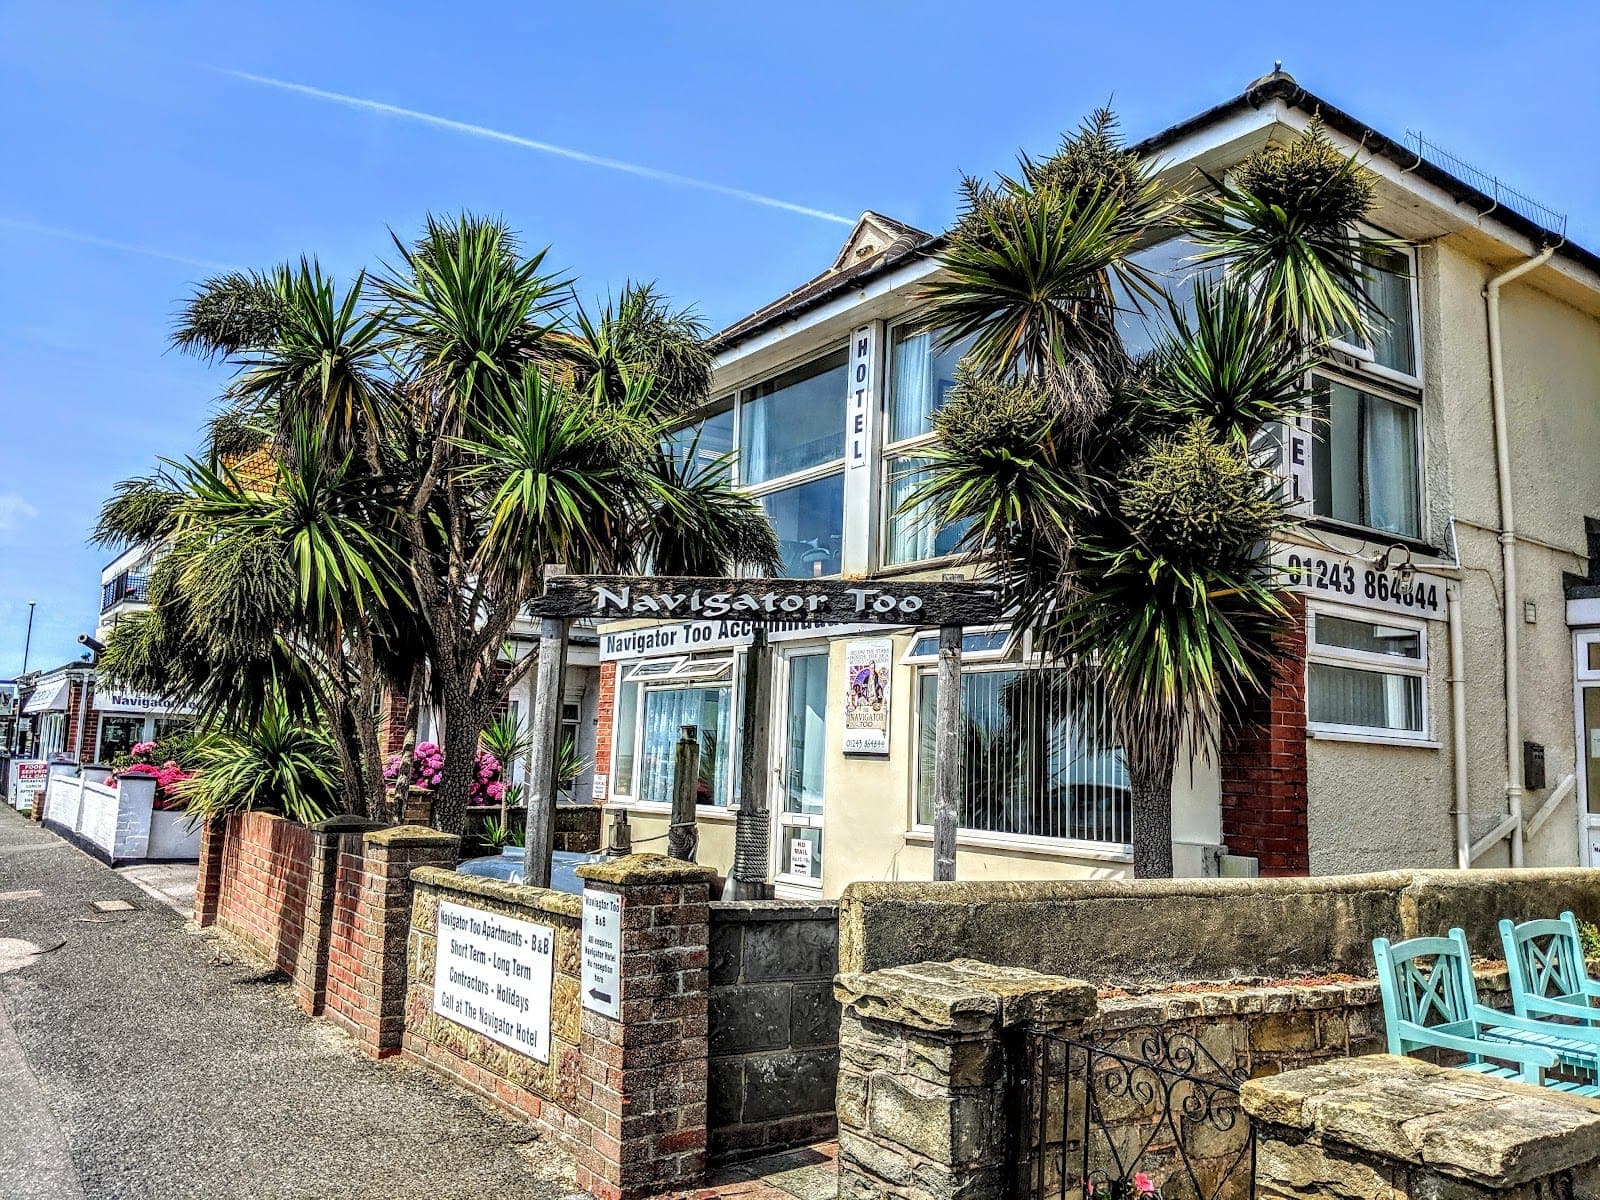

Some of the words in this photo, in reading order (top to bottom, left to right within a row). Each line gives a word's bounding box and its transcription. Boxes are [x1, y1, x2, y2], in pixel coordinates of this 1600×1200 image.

[854, 337, 868, 460] HOTEL
[1287, 554, 1356, 595] 01243
[593, 585, 829, 617] Navigator
[845, 588, 923, 614] Too
[606, 627, 677, 654] Navigator
[683, 624, 712, 643] Too
[112, 695, 175, 708] Navigator
[610, 901, 620, 913] Too
[440, 909, 468, 932] Navigator
[469, 918, 481, 936] Too
[482, 921, 523, 947] Apartments
[450, 939, 468, 957] Short
[469, 944, 487, 965] Term
[493, 952, 510, 977] Long
[512, 958, 532, 981] Term
[449, 966, 489, 995] Contractors
[496, 984, 530, 1014] Holidays
[441, 991, 454, 1009] Call
[455, 996, 462, 1012] at
[465, 1001, 477, 1020] The
[479, 1006, 514, 1036] Navigator
[516, 1022, 538, 1048] Hotel
